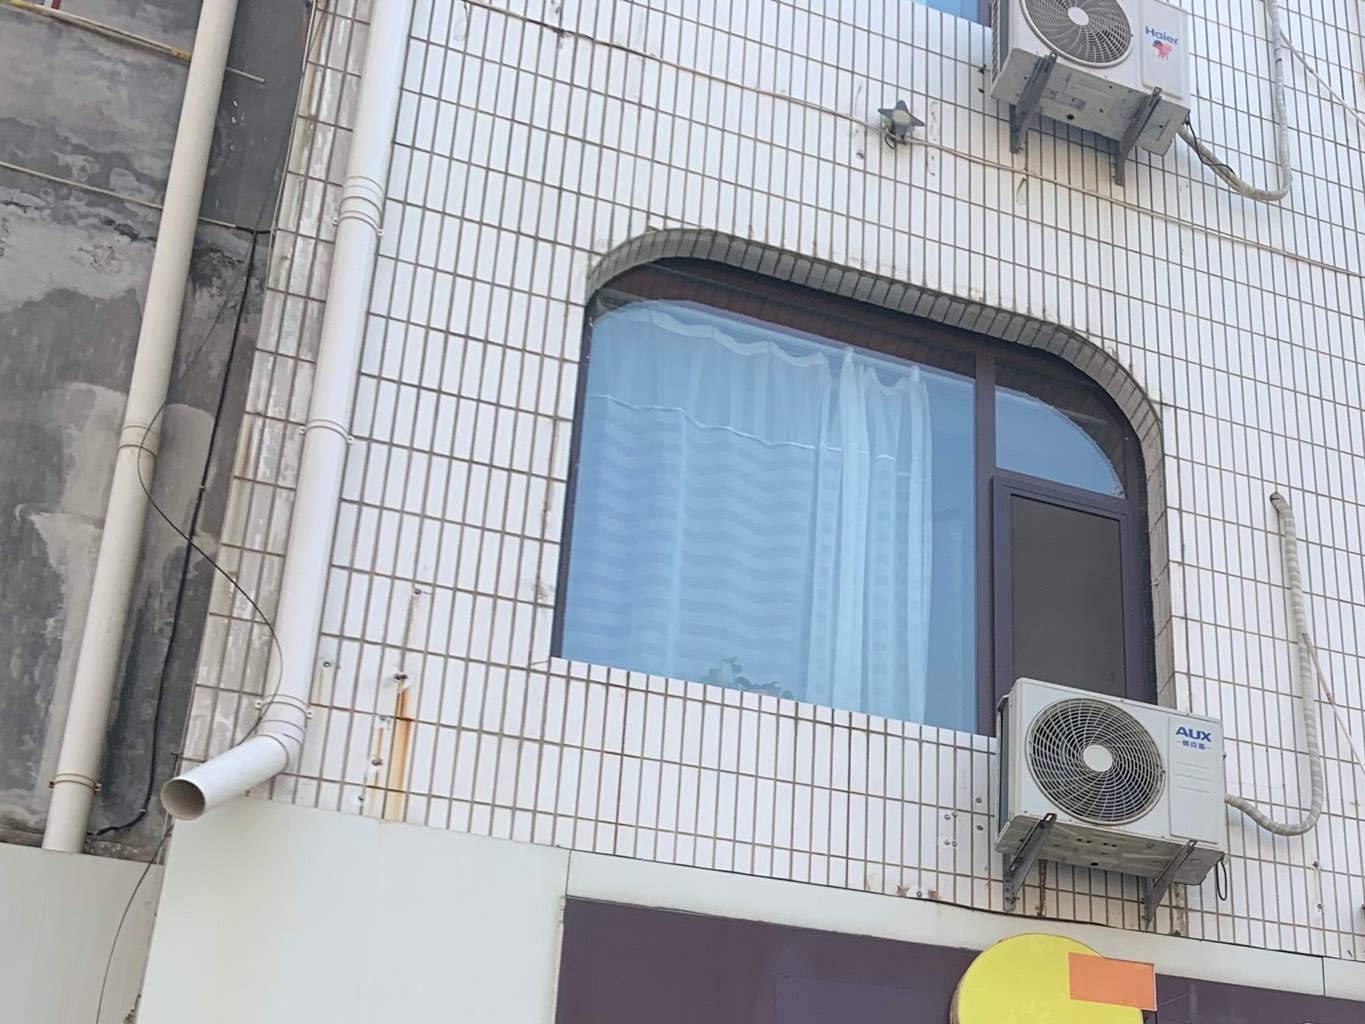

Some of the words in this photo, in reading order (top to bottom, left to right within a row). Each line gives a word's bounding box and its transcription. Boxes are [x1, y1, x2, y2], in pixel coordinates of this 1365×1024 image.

[1145, 26, 1178, 45] Haier
[1175, 726, 1212, 742] AUX
[1182, 739, 1206, 750] 奥克斯
